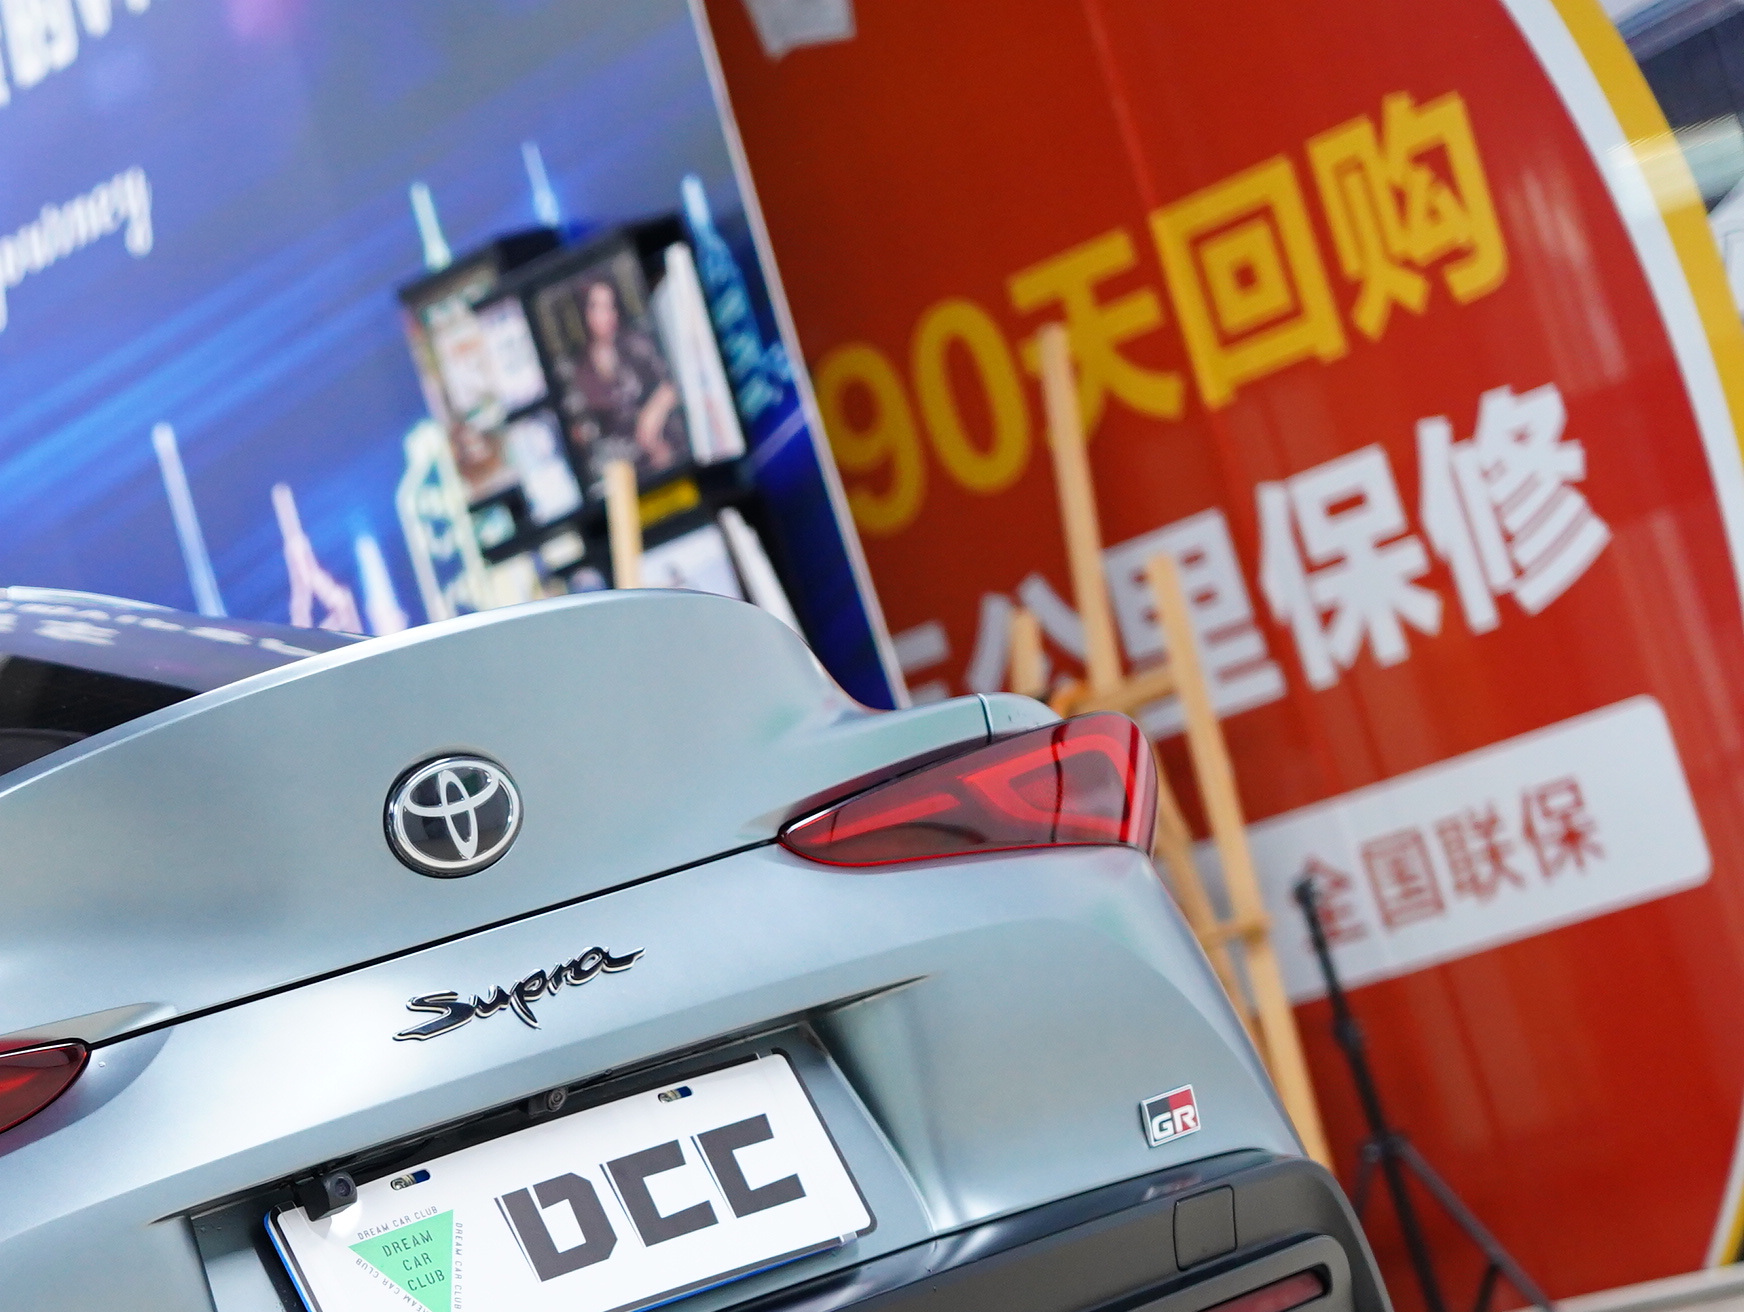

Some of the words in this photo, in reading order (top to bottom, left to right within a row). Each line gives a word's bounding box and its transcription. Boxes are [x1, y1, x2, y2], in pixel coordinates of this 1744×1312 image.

[814, 89, 1509, 536] 90天回购
[1293, 770, 1606, 955] 全国联保
[392, 944, 646, 1042] Supra
[1151, 1103, 1197, 1141] GR
[494, 1112, 807, 1283] DCC
[357, 1222, 389, 1241] DREAM
[392, 1215, 412, 1228] CAR
[414, 1205, 438, 1220] CLUB
[381, 1230, 433, 1257] DREAM
[455, 1222, 464, 1256] DREAM
[355, 1257, 380, 1279] CLUB
[402, 1252, 433, 1272] CAR
[454, 1260, 463, 1280] CAR
[381, 1277, 401, 1295] CAR
[407, 1269, 445, 1291] CLUB
[454, 1284, 462, 1310] CLUB
